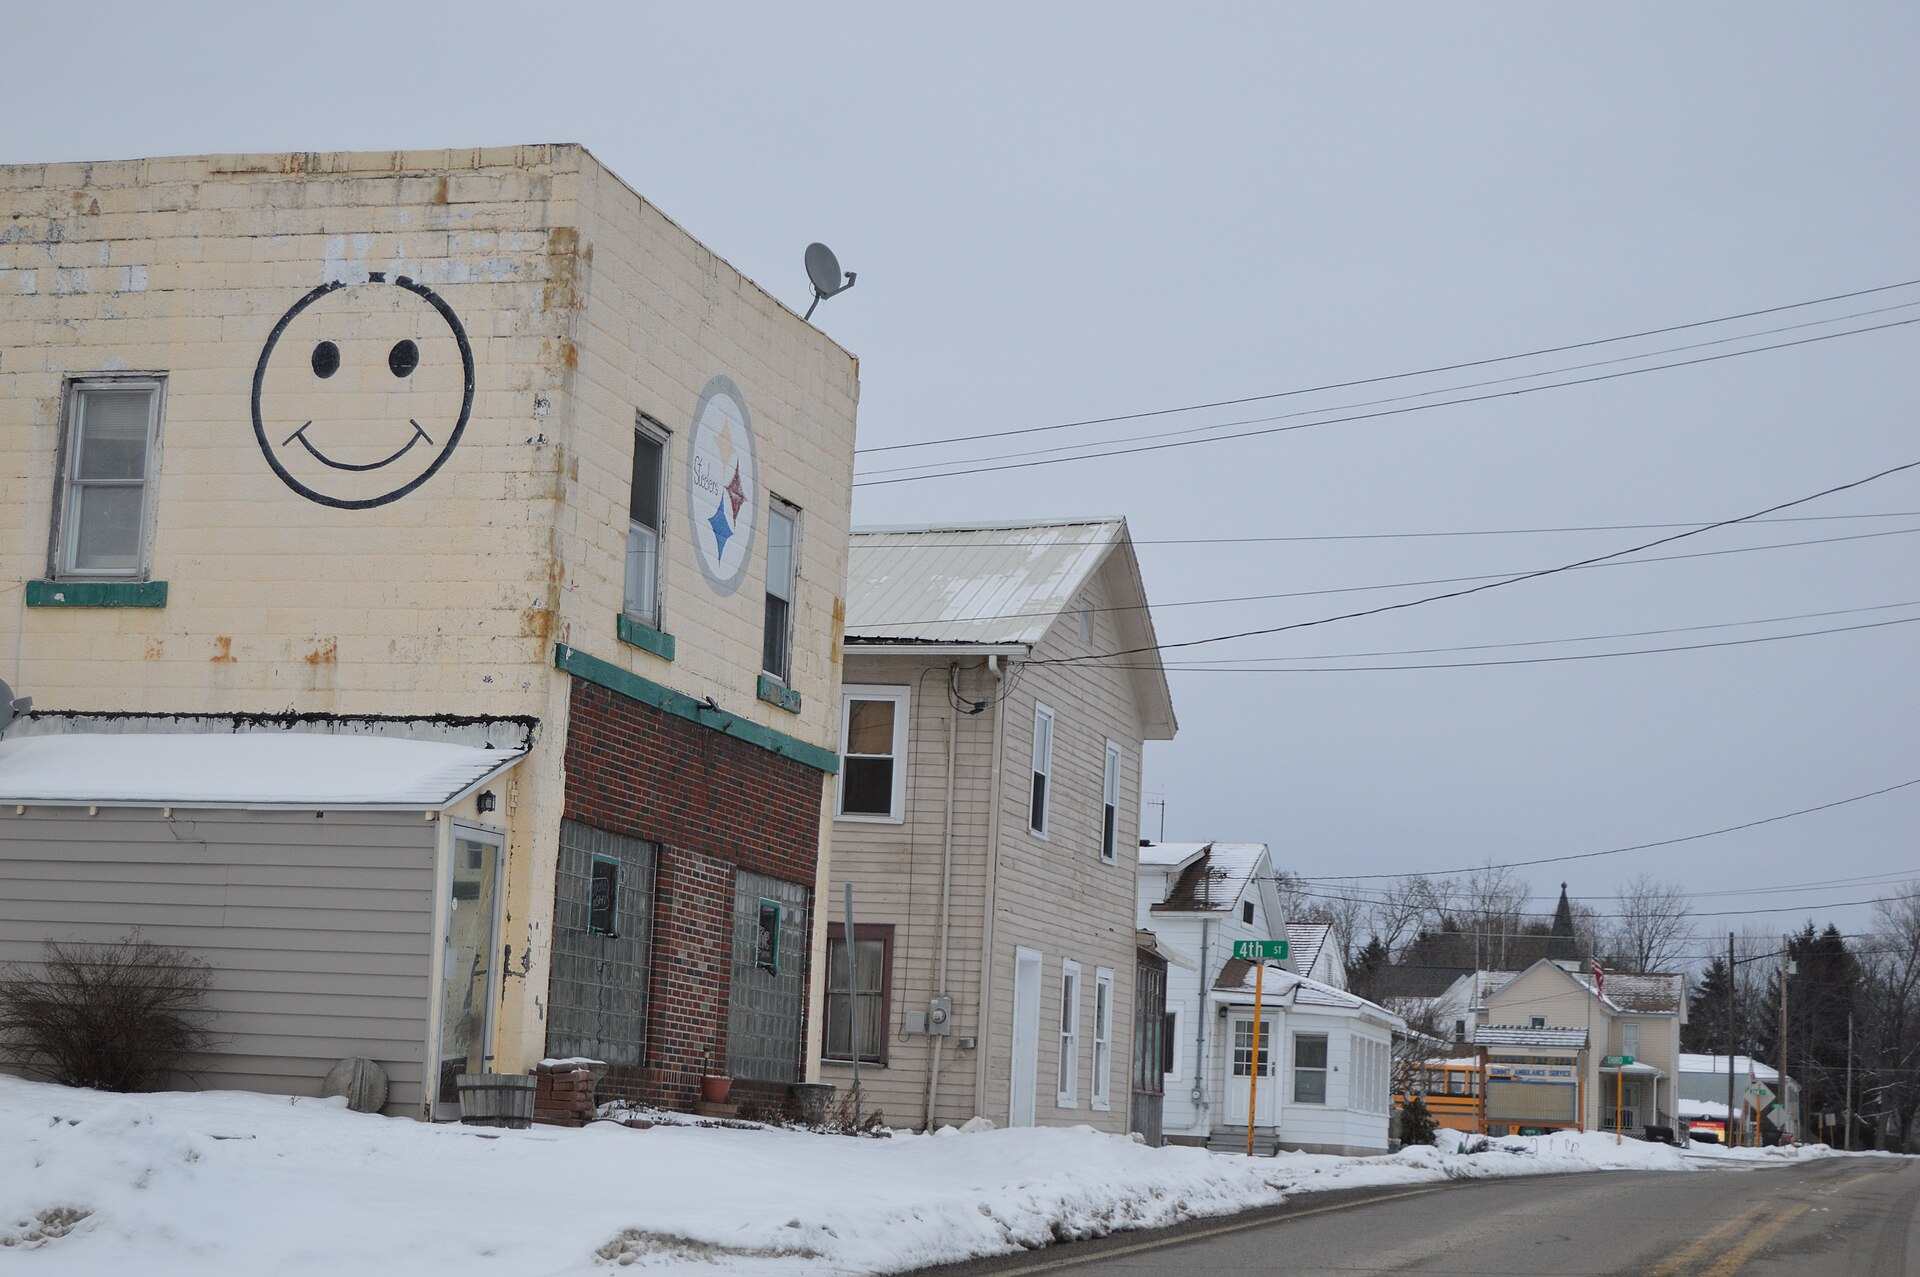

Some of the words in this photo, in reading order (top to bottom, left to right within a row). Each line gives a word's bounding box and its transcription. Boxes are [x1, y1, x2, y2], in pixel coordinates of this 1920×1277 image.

[693, 456, 719, 496] Steelers
[1239, 942, 1264, 957] 4th
[1274, 946, 1283, 955] ST
[1515, 1069, 1546, 1077] AMBULANCE
[1549, 1070, 1571, 1078] SERVICE
